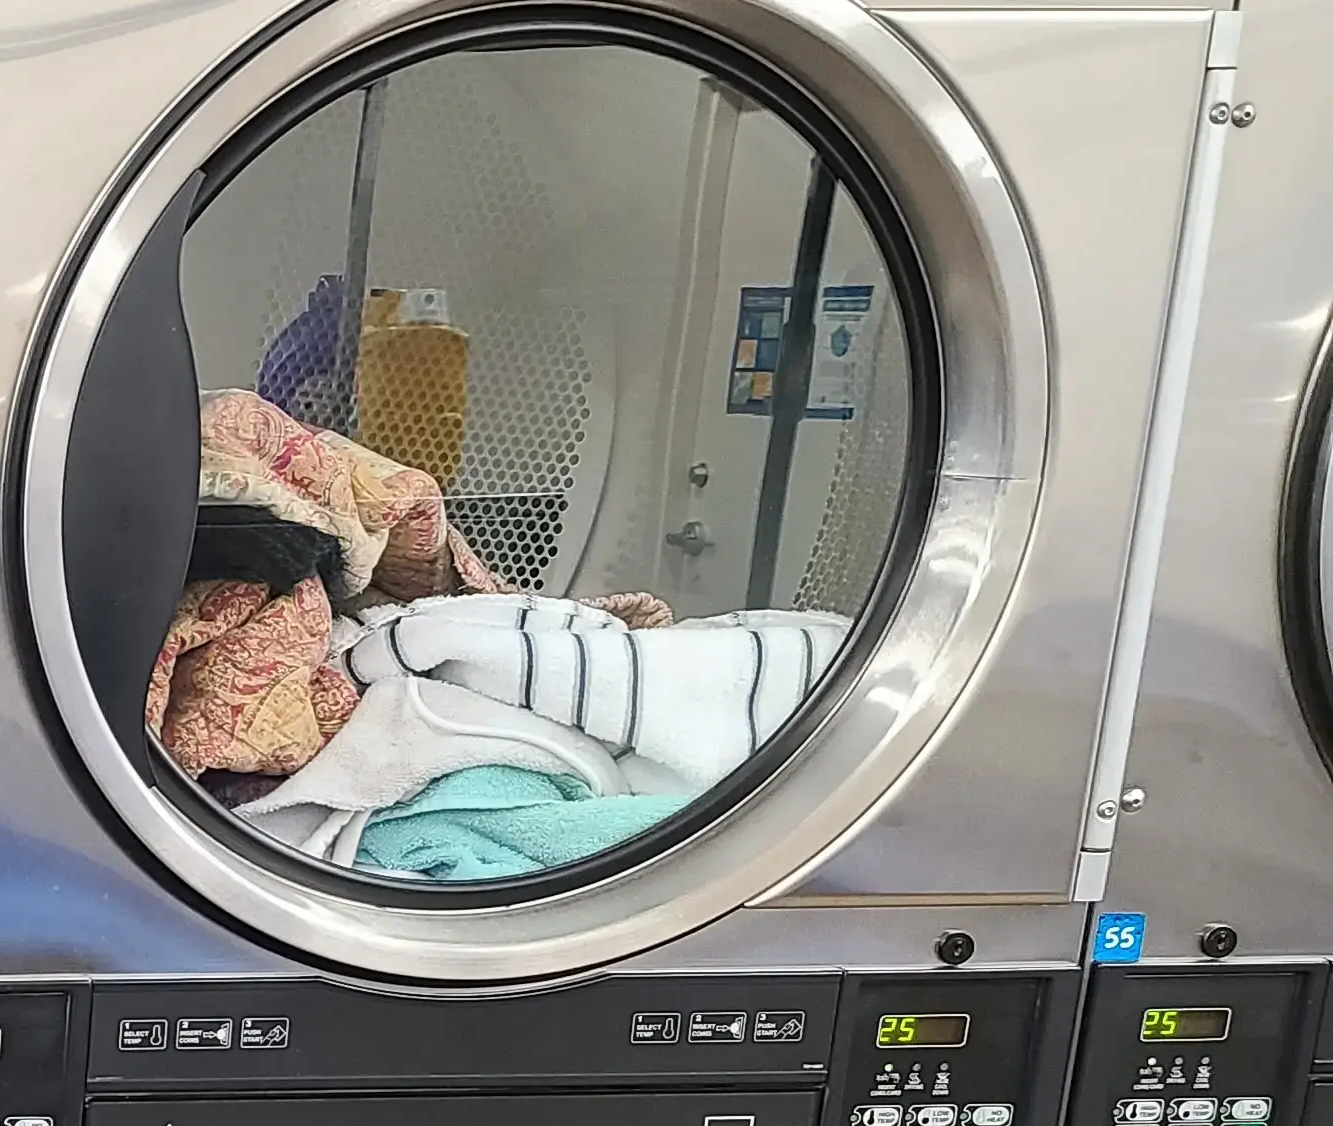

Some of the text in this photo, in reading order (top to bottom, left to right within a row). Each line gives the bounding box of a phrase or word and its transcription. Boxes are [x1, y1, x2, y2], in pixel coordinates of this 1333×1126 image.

[1105, 926, 1135, 949] 55
[124, 1022, 130, 1030] 1
[760, 1013, 767, 1021] 3
[1142, 1010, 1179, 1036] 25
[879, 1018, 916, 1043] 25
